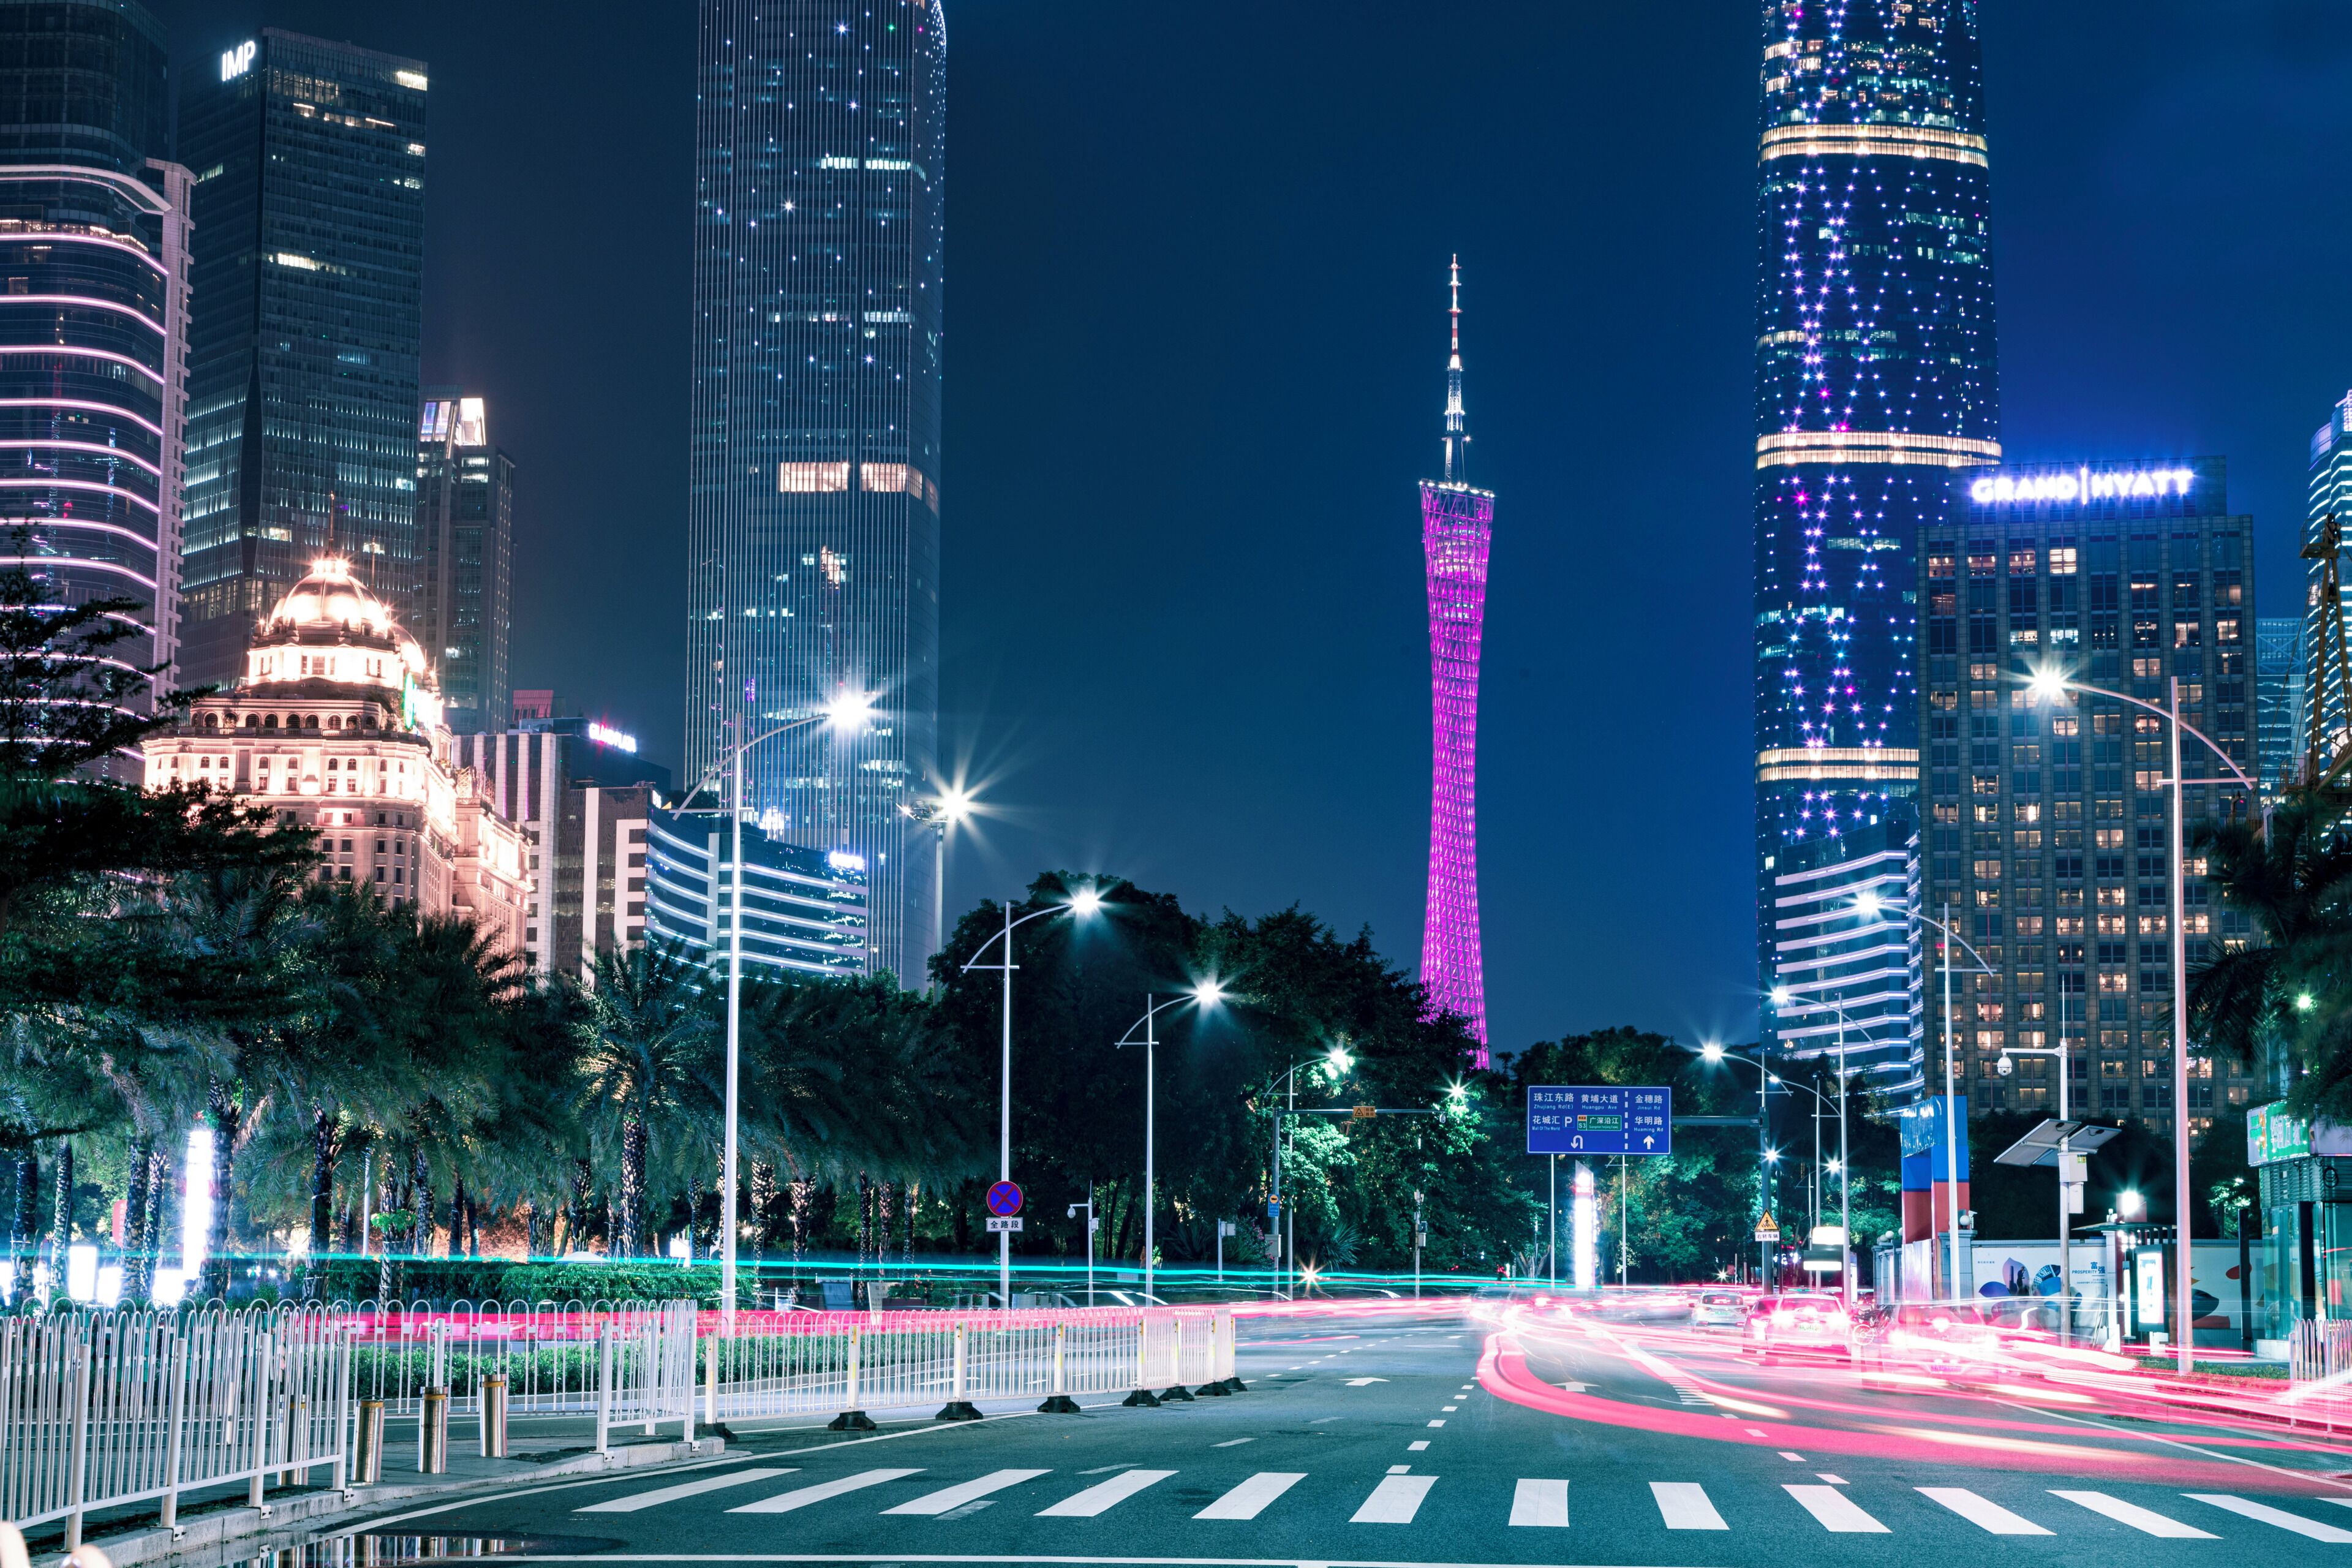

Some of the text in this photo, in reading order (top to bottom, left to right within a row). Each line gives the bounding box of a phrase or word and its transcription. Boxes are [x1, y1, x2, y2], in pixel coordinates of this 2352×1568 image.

[222, 40, 256, 81] IMP
[1970, 470, 2194, 502] GRAND HYATT
[1534, 1093, 1574, 1102] 珠江东路
[1581, 1094, 1618, 1103] 黄埔大道
[1635, 1095, 1662, 1104] 金穗路
[1532, 1115, 1560, 1125] 花城汇
[1564, 1117, 1572, 1127] P
[1635, 1116, 1662, 1125] 华明路
[2090, 1261, 2106, 1273] 富强
